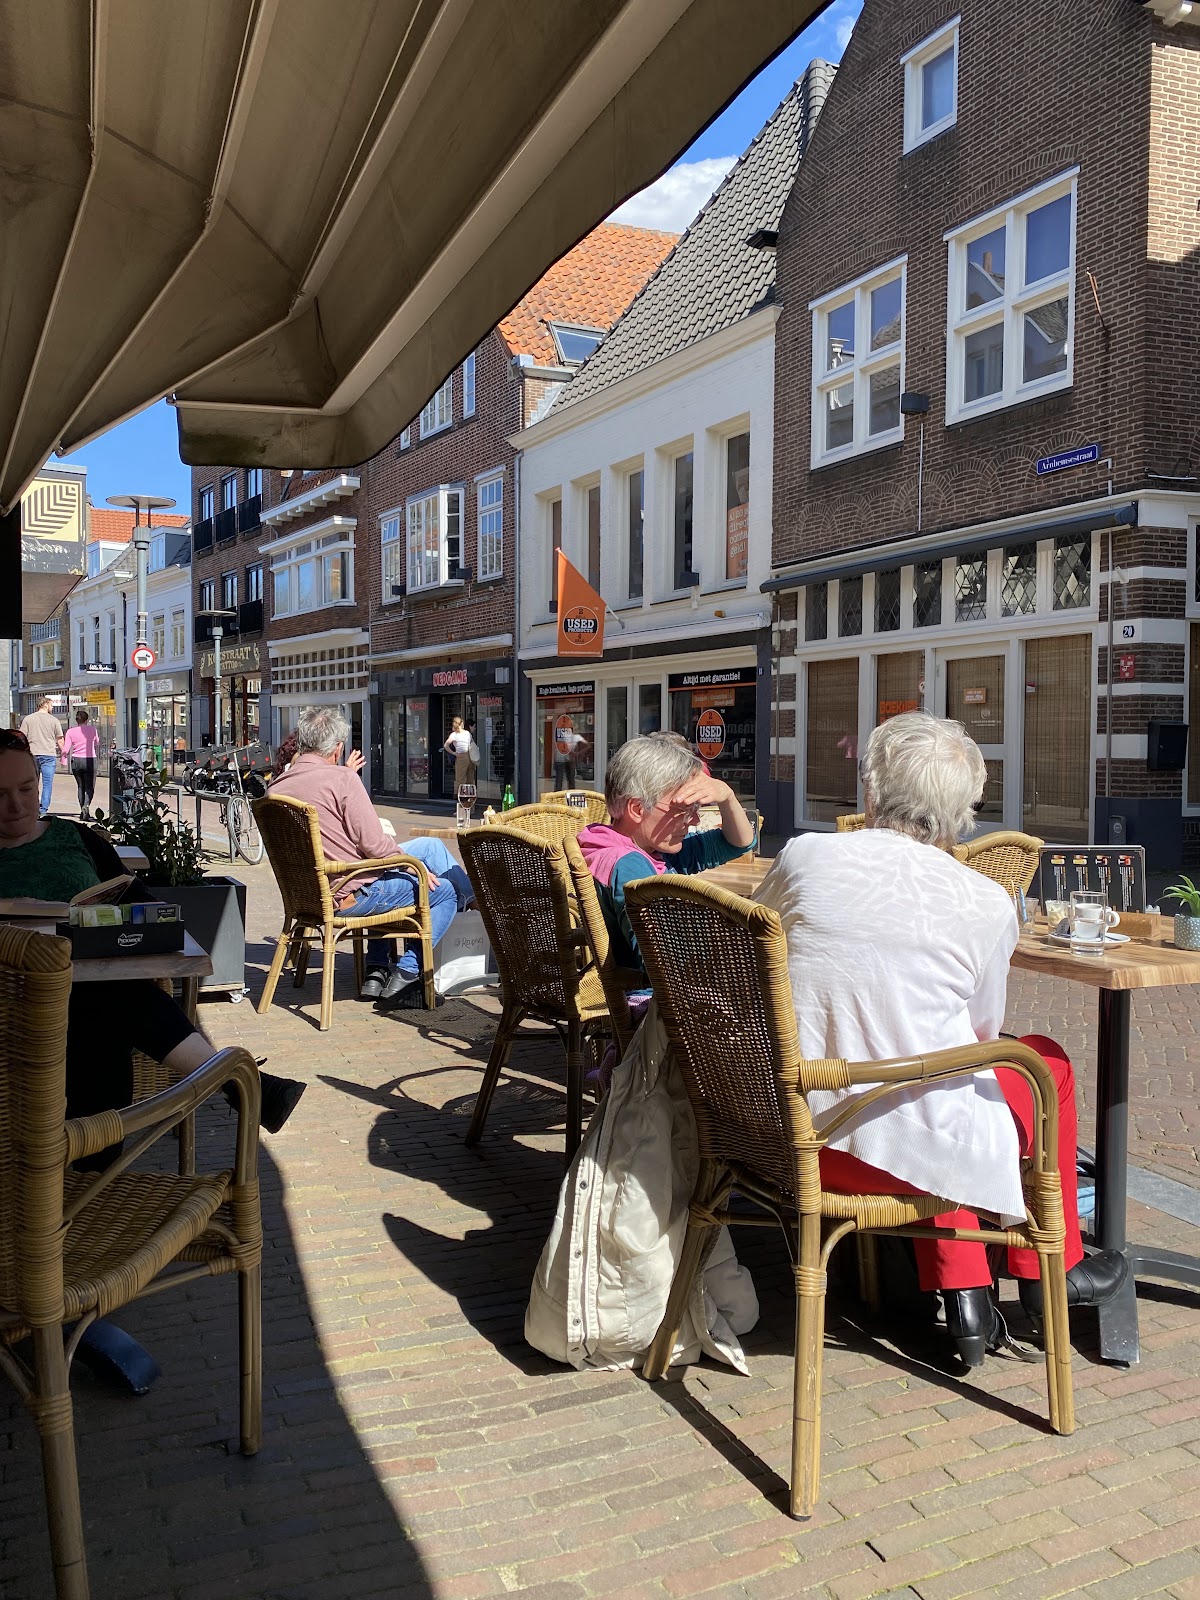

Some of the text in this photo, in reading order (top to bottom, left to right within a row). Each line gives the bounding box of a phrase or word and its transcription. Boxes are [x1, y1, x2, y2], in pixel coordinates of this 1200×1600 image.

[1041, 451, 1093, 470] Arnhemsestraat
[567, 618, 594, 628] USED
[1124, 626, 1132, 638] 20
[433, 669, 468, 687] NEDGAME
[682, 676, 698, 685] Altijd
[712, 671, 740, 684] garantie!
[700, 726, 722, 738] USED
